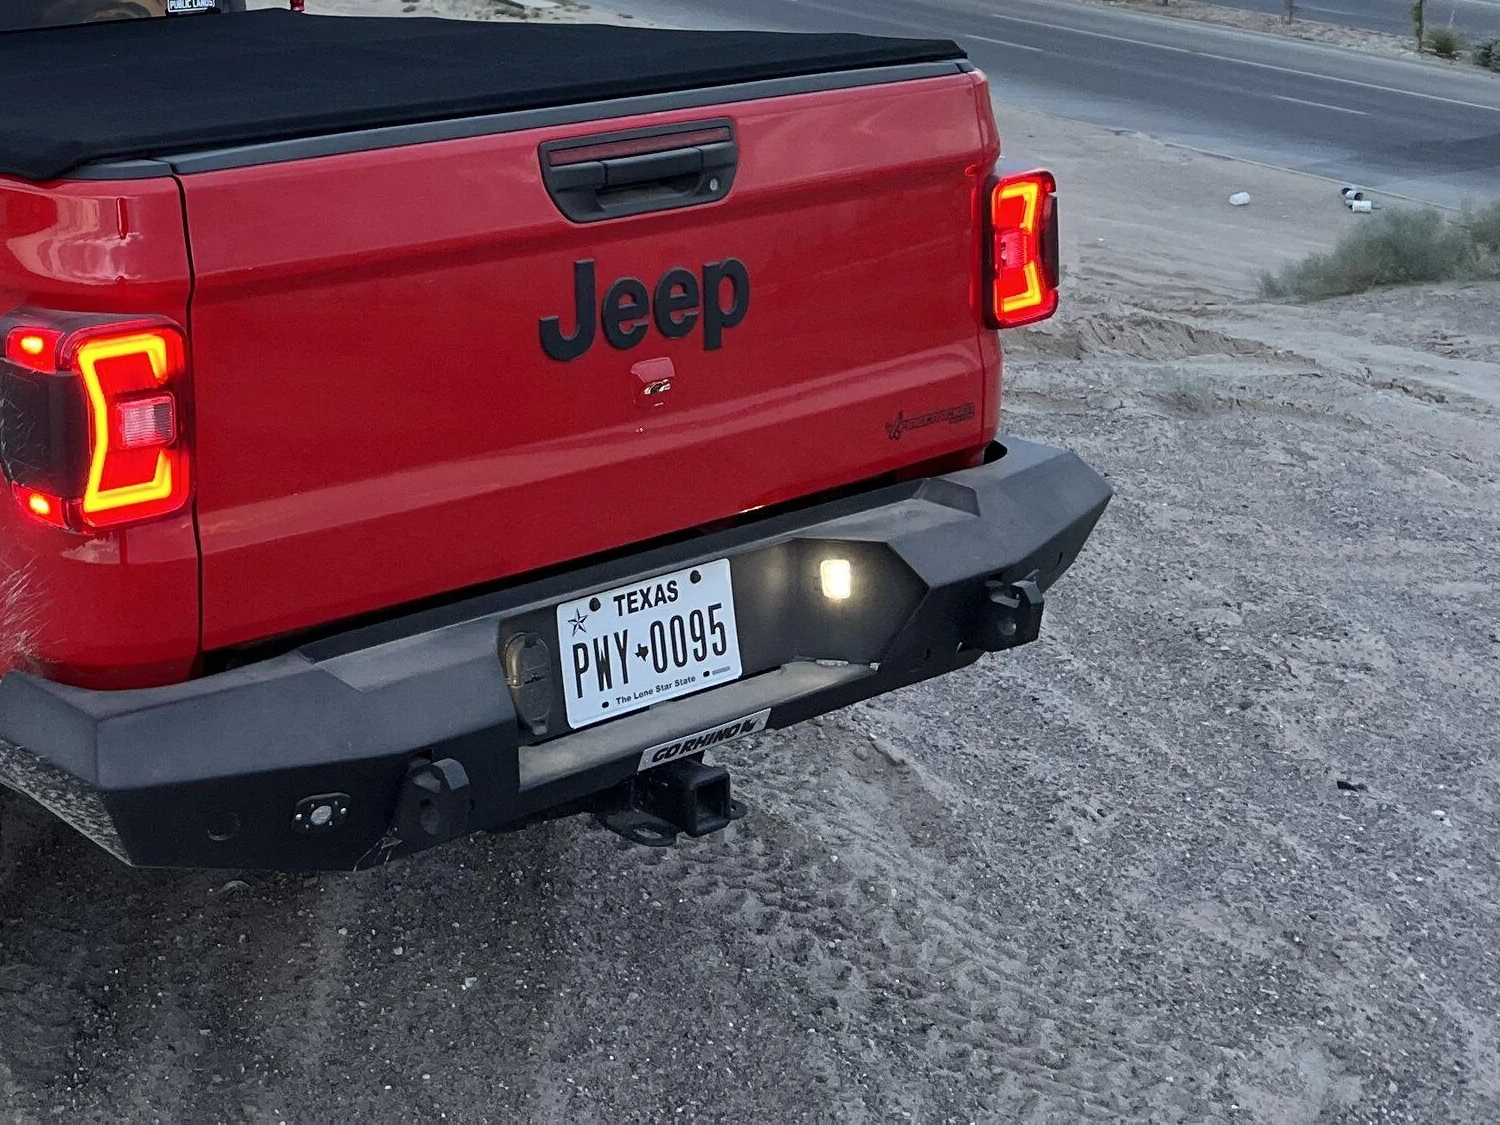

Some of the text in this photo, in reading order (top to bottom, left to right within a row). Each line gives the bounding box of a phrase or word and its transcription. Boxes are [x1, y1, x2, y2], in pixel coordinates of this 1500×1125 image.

[170, 0, 192, 9] PUBLIC
[539, 257, 750, 362] Jeep
[613, 580, 679, 617] TEXAS
[572, 603, 728, 699] PWY 0095
[616, 675, 697, 706] The Lone Star State
